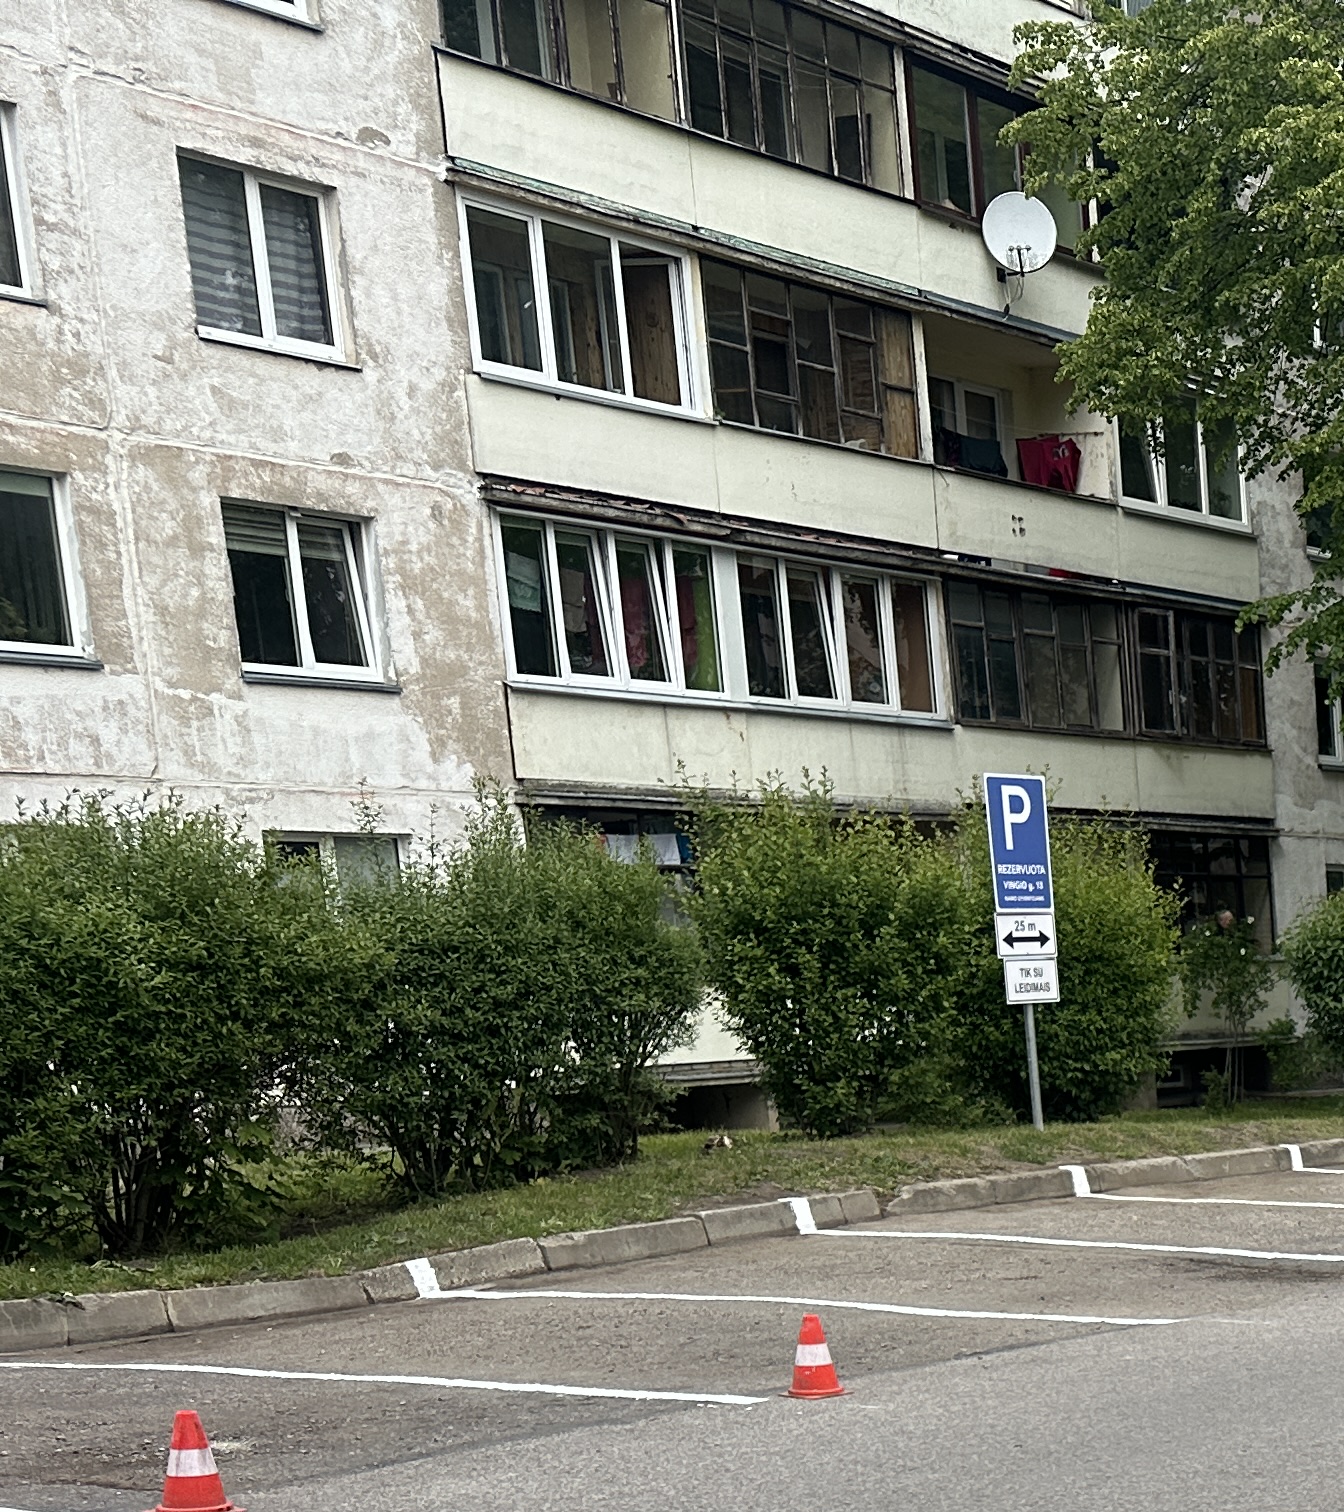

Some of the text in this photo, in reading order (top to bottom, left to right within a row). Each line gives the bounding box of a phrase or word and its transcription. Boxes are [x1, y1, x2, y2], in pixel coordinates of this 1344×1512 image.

[1001, 785, 1031, 850] P
[997, 864, 1046, 875] REZERVUOTA
[1014, 920, 1036, 932] 25 m
[1020, 967, 1044, 979] TIK SU
[1014, 982, 1051, 994] LEIDIMAIS
